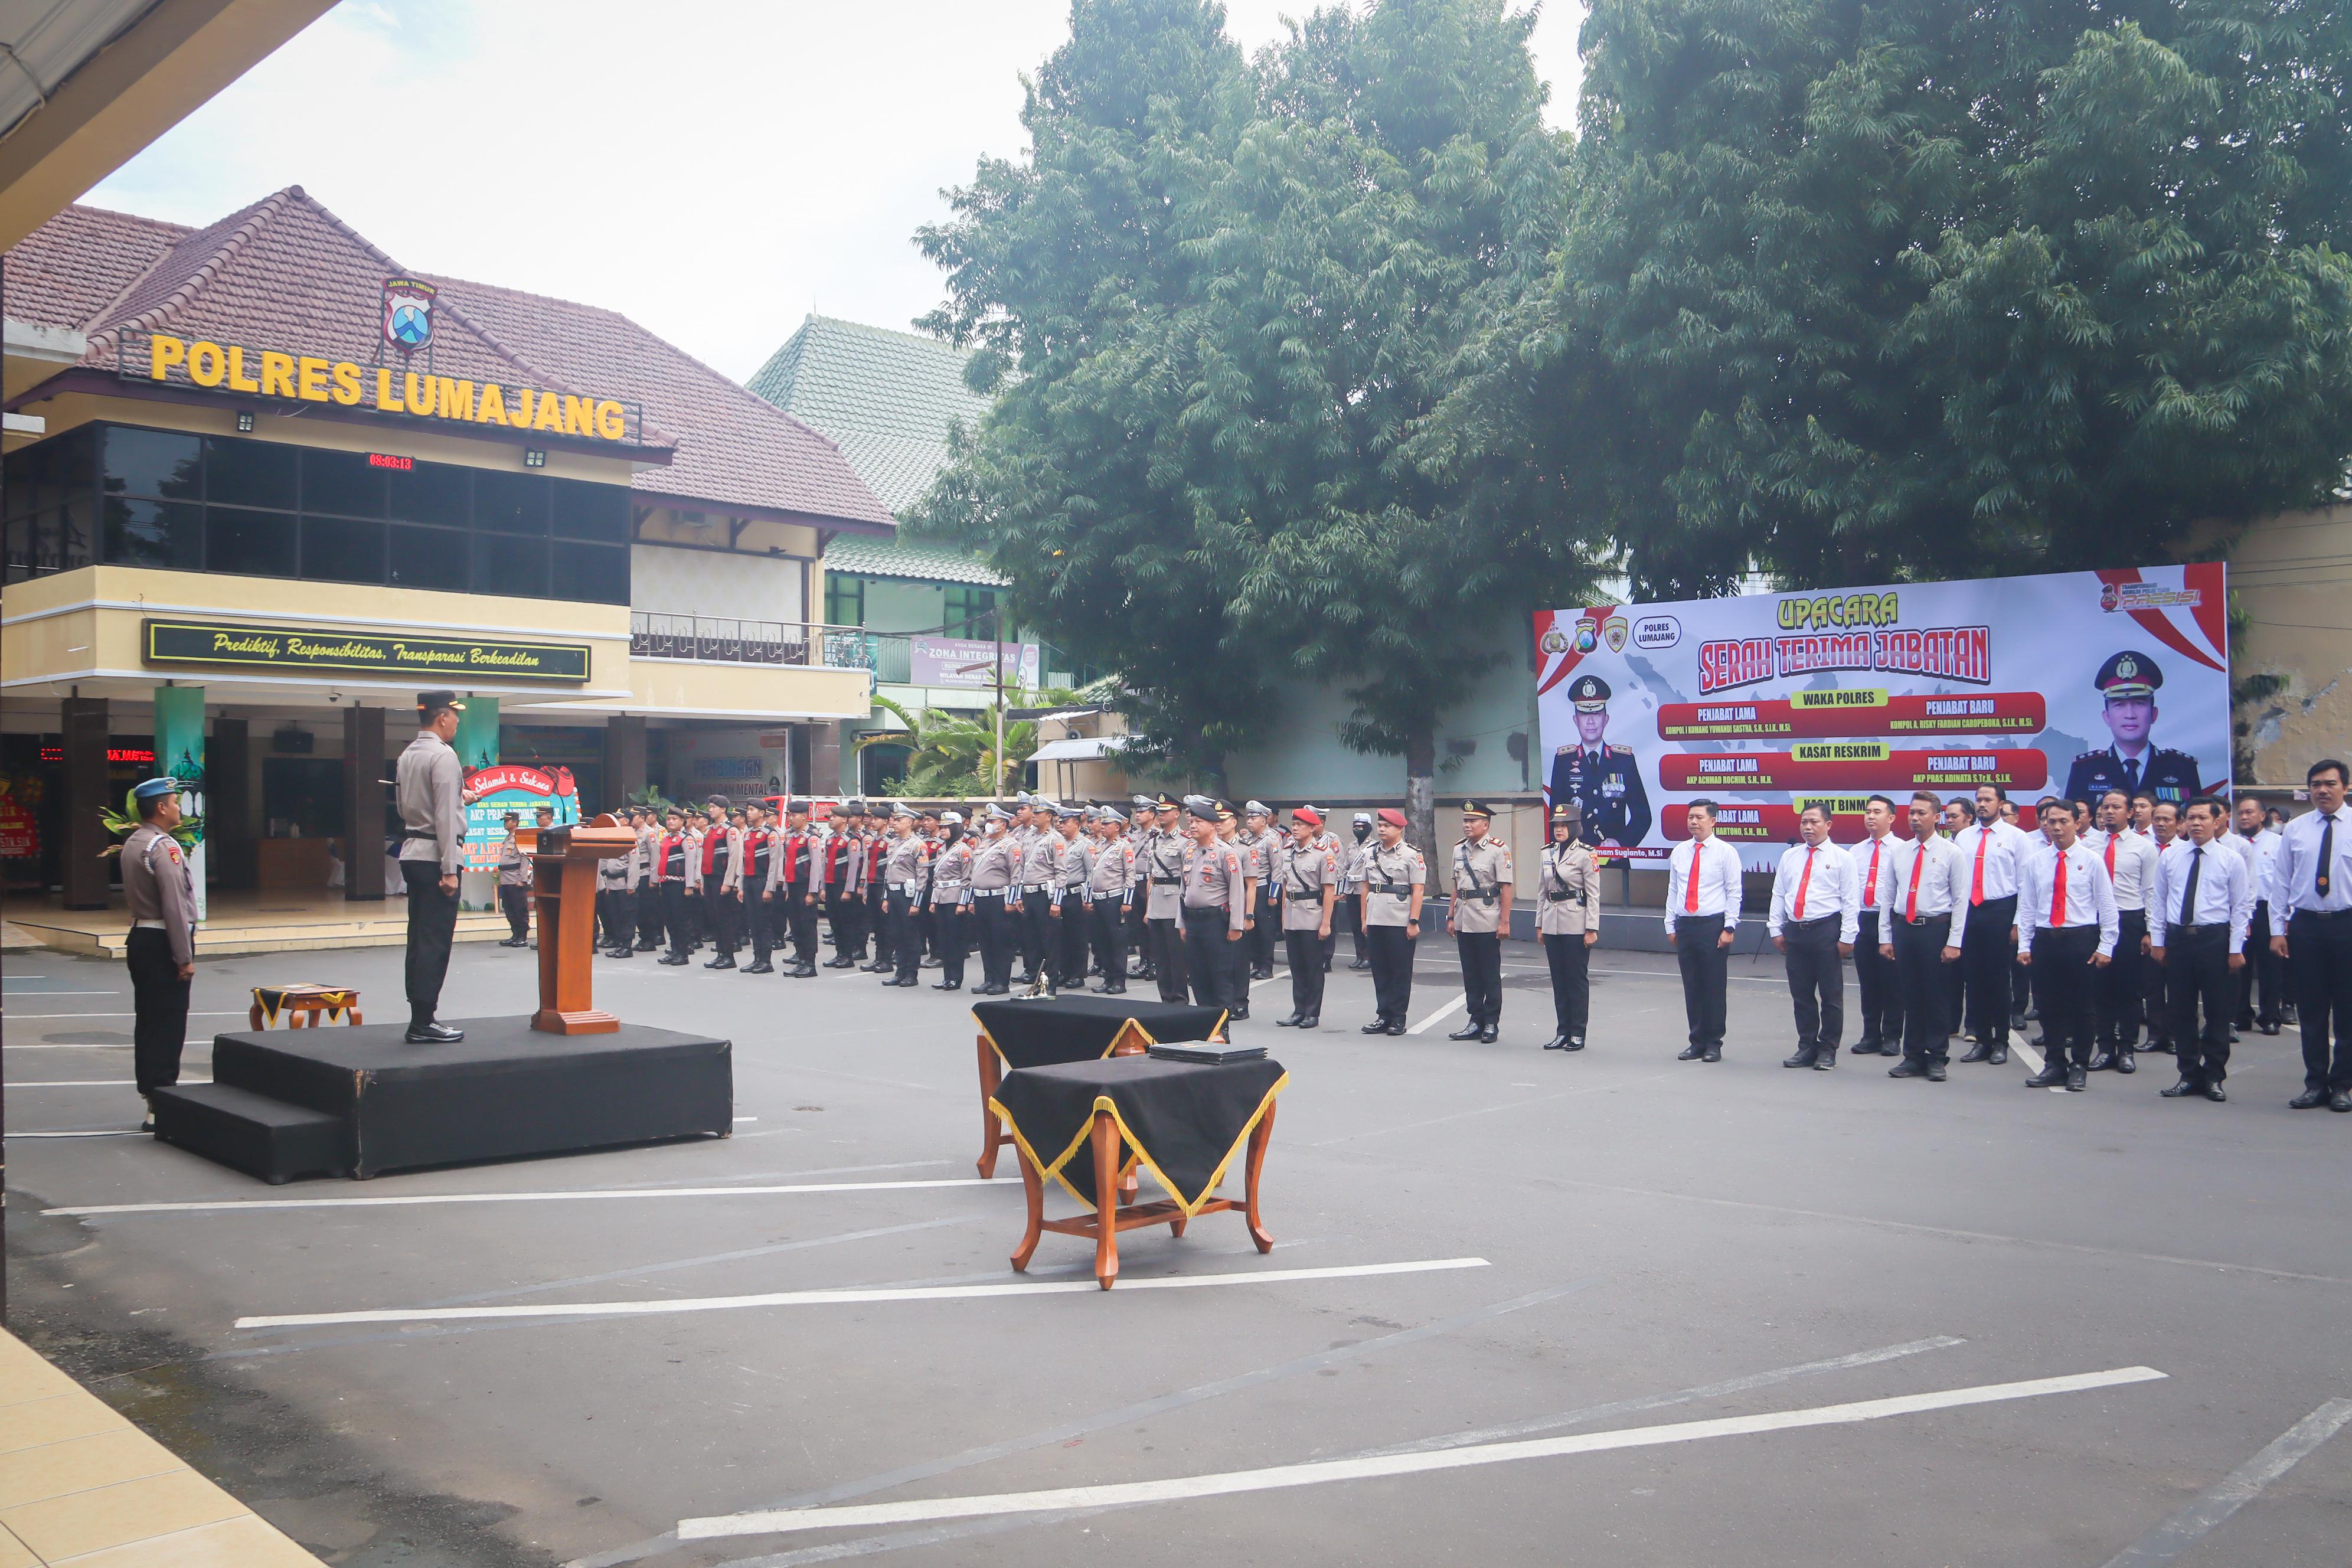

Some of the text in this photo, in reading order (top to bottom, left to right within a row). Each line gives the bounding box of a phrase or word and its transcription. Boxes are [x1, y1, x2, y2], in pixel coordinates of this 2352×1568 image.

[411, 281, 435, 295] TIMUR
[152, 334, 624, 440] POLRES LUMAJANG
[370, 453, 412, 469] 08:03:13
[2124, 591, 2200, 605] PRESISI
[1778, 593, 1897, 630] UPACARA
[1644, 623, 1670, 632] POLRES
[1639, 633, 1675, 642] LUMAJANG
[214, 633, 539, 666] Prediktif, Responsibilitas, Transparasi Berkeadilan
[929, 648, 956, 658] ZONA
[1700, 627, 1990, 693] SERAH TERIMA JABATAN
[1803, 692, 1874, 705] WAKA POLRES
[1926, 699, 1994, 715] PENJABAT BARU
[1698, 707, 1756, 721] PENJABAT LAMA
[1709, 725, 1732, 733] YUWANDI
[1733, 724, 1753, 733] SASTRA,
[1890, 720, 1912, 729] KOMPOL
[1913, 720, 1919, 729] A.
[1919, 720, 1936, 729] RISKY
[1937, 719, 1961, 729] FARDIAN
[1962, 718, 2001, 729] CAROPEBOKA,
[1800, 746, 1881, 758] KASAT RESKRIM
[694, 756, 762, 779] PEMBINAAN
[1700, 759, 1758, 772] PENJABAT LAMA
[1928, 756, 1995, 770] PENJABAT BARU
[475, 772, 549, 792] Selamat & Sukses
[1723, 776, 1746, 785] ROCHIM,
[1760, 776, 1772, 784] M.H.
[1913, 775, 1926, 783] AKP
[1926, 775, 1944, 783] PRAS
[1945, 775, 1972, 783] ADINATA
[1995, 774, 2011, 783] S.I.K.
[718, 783, 734, 795] DAN
[737, 783, 767, 795] MENTAL
[1838, 799, 1869, 811] BINM
[471, 809, 485, 821] AKP
[1738, 810, 1759, 823] LAMA
[1716, 828, 1743, 836] HARTONO,
[463, 843, 478, 855] AKP
[1614, 849, 1647, 858] Sugianto,
